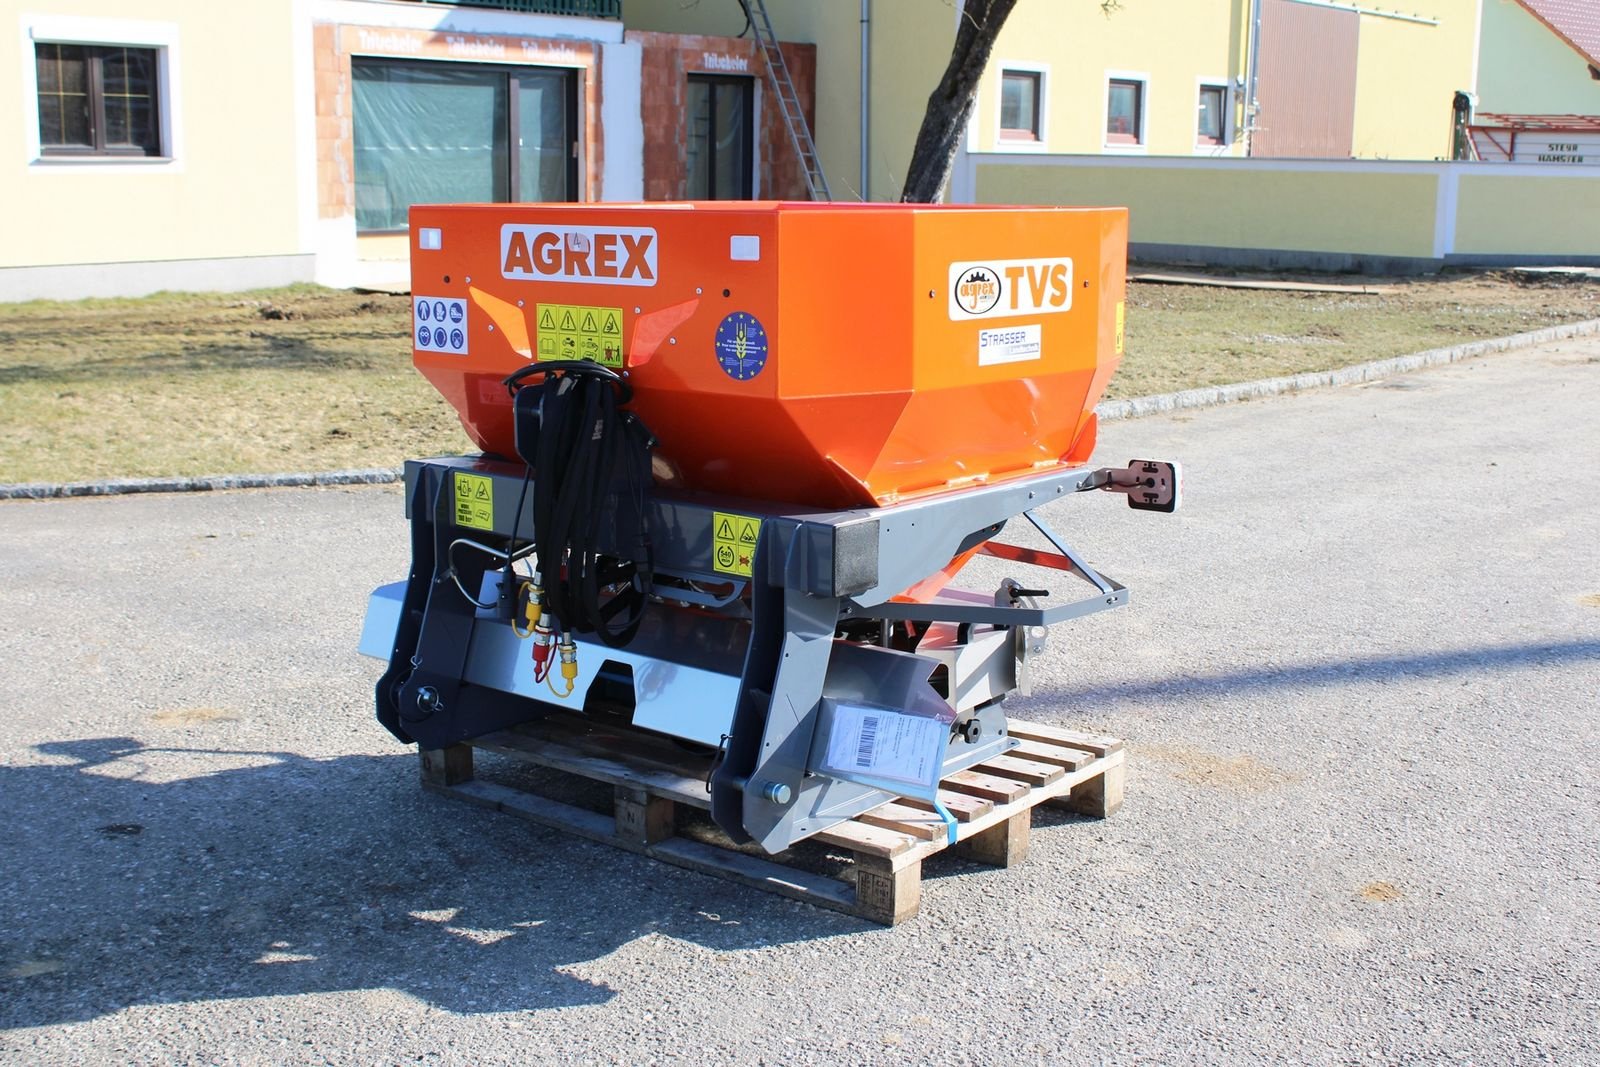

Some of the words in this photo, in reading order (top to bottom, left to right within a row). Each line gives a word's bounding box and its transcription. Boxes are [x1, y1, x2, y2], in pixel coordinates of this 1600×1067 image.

[503, 231, 655, 279] AGREX
[1005, 264, 1068, 310] TVS
[981, 331, 1026, 347] STRASSER
